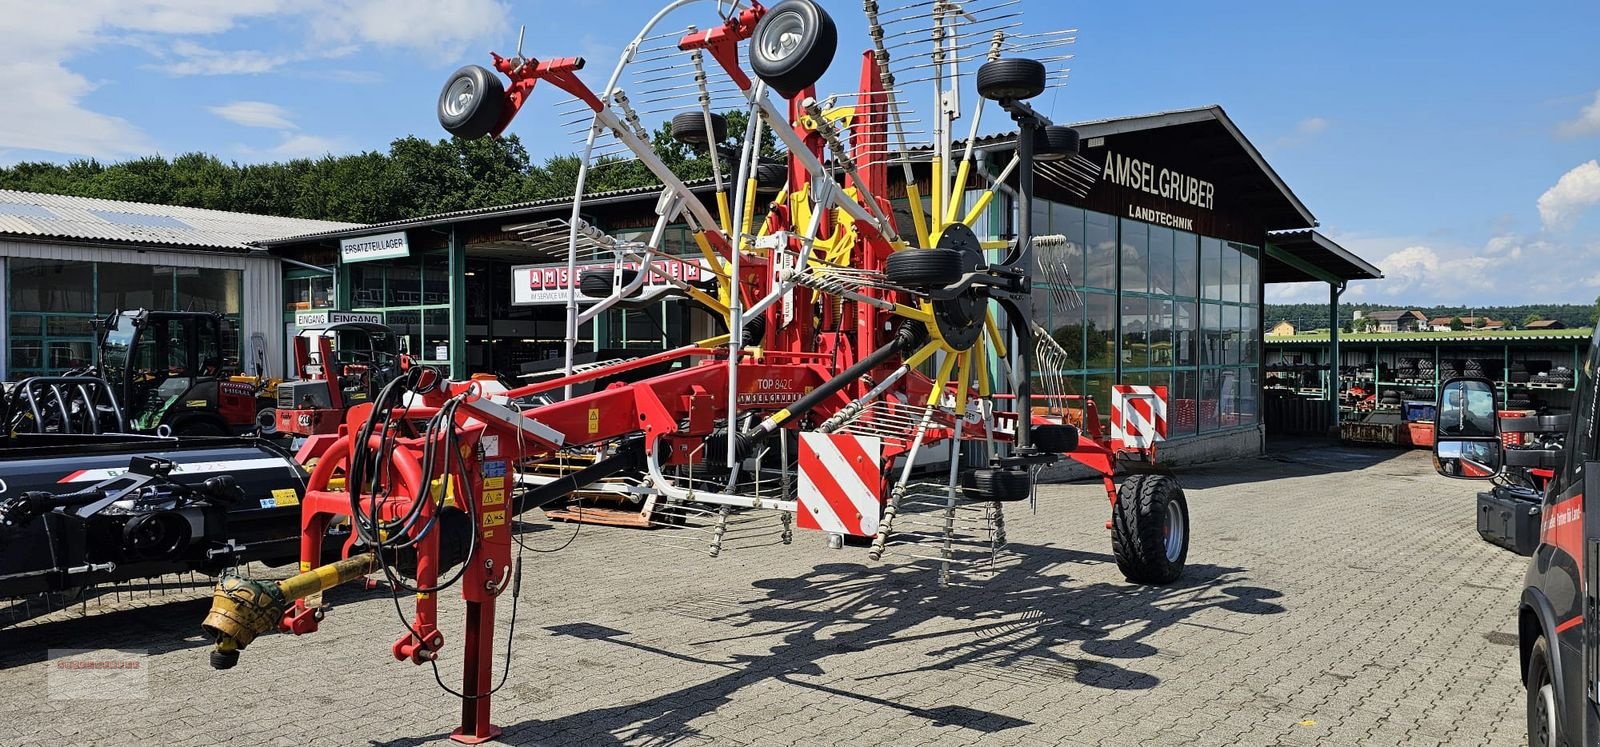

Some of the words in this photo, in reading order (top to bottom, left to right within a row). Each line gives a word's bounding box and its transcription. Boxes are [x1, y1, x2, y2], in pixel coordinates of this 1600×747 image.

[1103, 150, 1214, 210] AMSELGRUBER
[1129, 204, 1193, 230] LANDTECHNIK
[345, 238, 403, 254] ERSATZTEILLAGER
[298, 315, 325, 325] EINGANG
[333, 314, 378, 324] EINGANG
[758, 379, 773, 389] TOP
